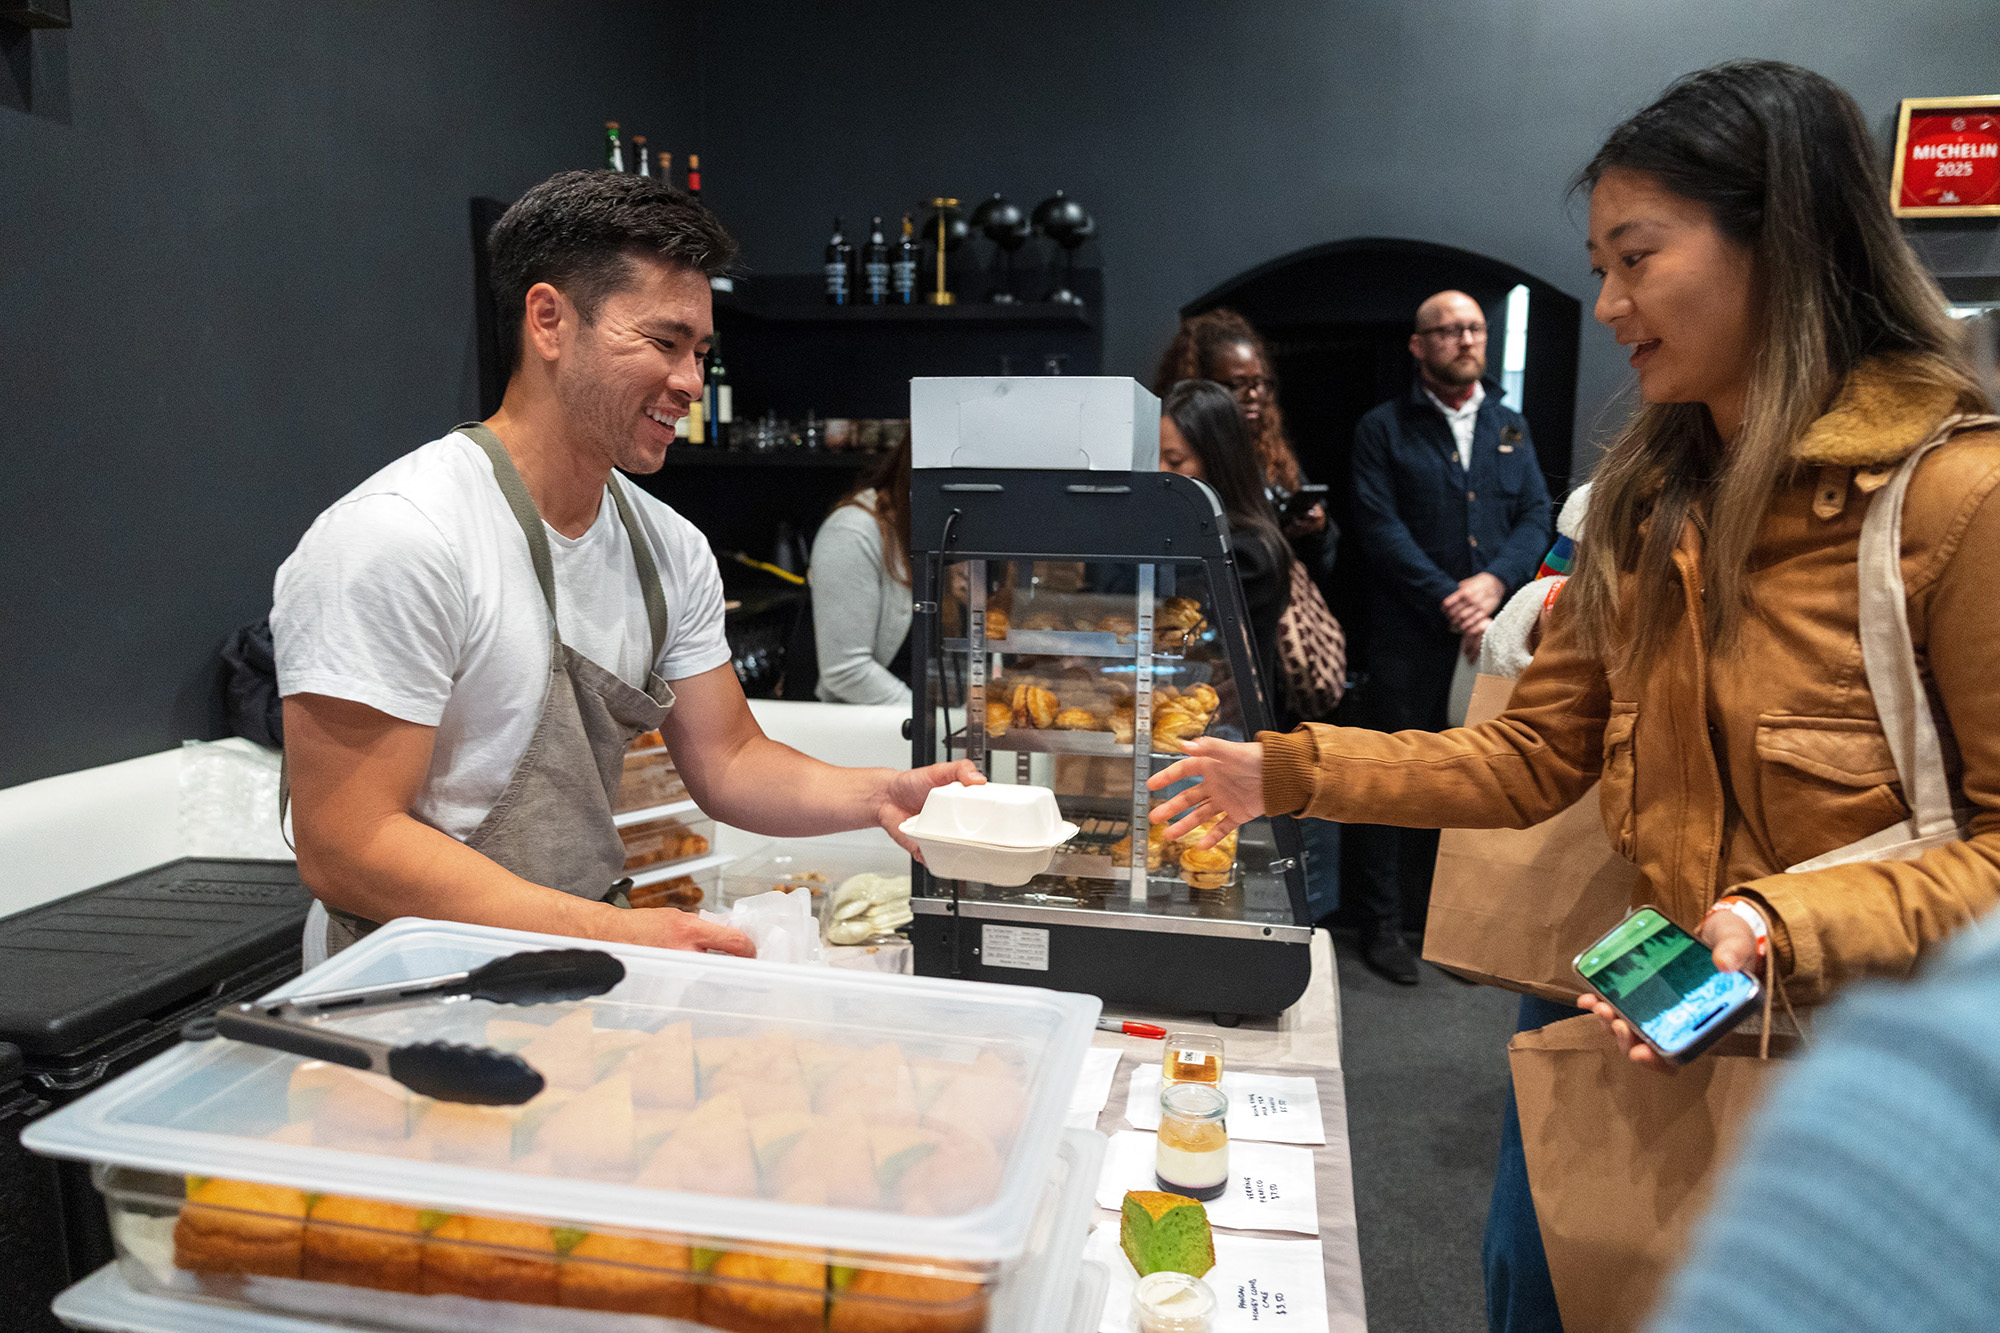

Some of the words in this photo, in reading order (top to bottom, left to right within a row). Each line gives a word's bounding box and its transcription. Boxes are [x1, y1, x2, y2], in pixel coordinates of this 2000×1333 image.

[1913, 143, 1999, 160] MICHELIN
[1935, 161, 1974, 177] 2025
[1260, 1290, 1269, 1309] CAKE
